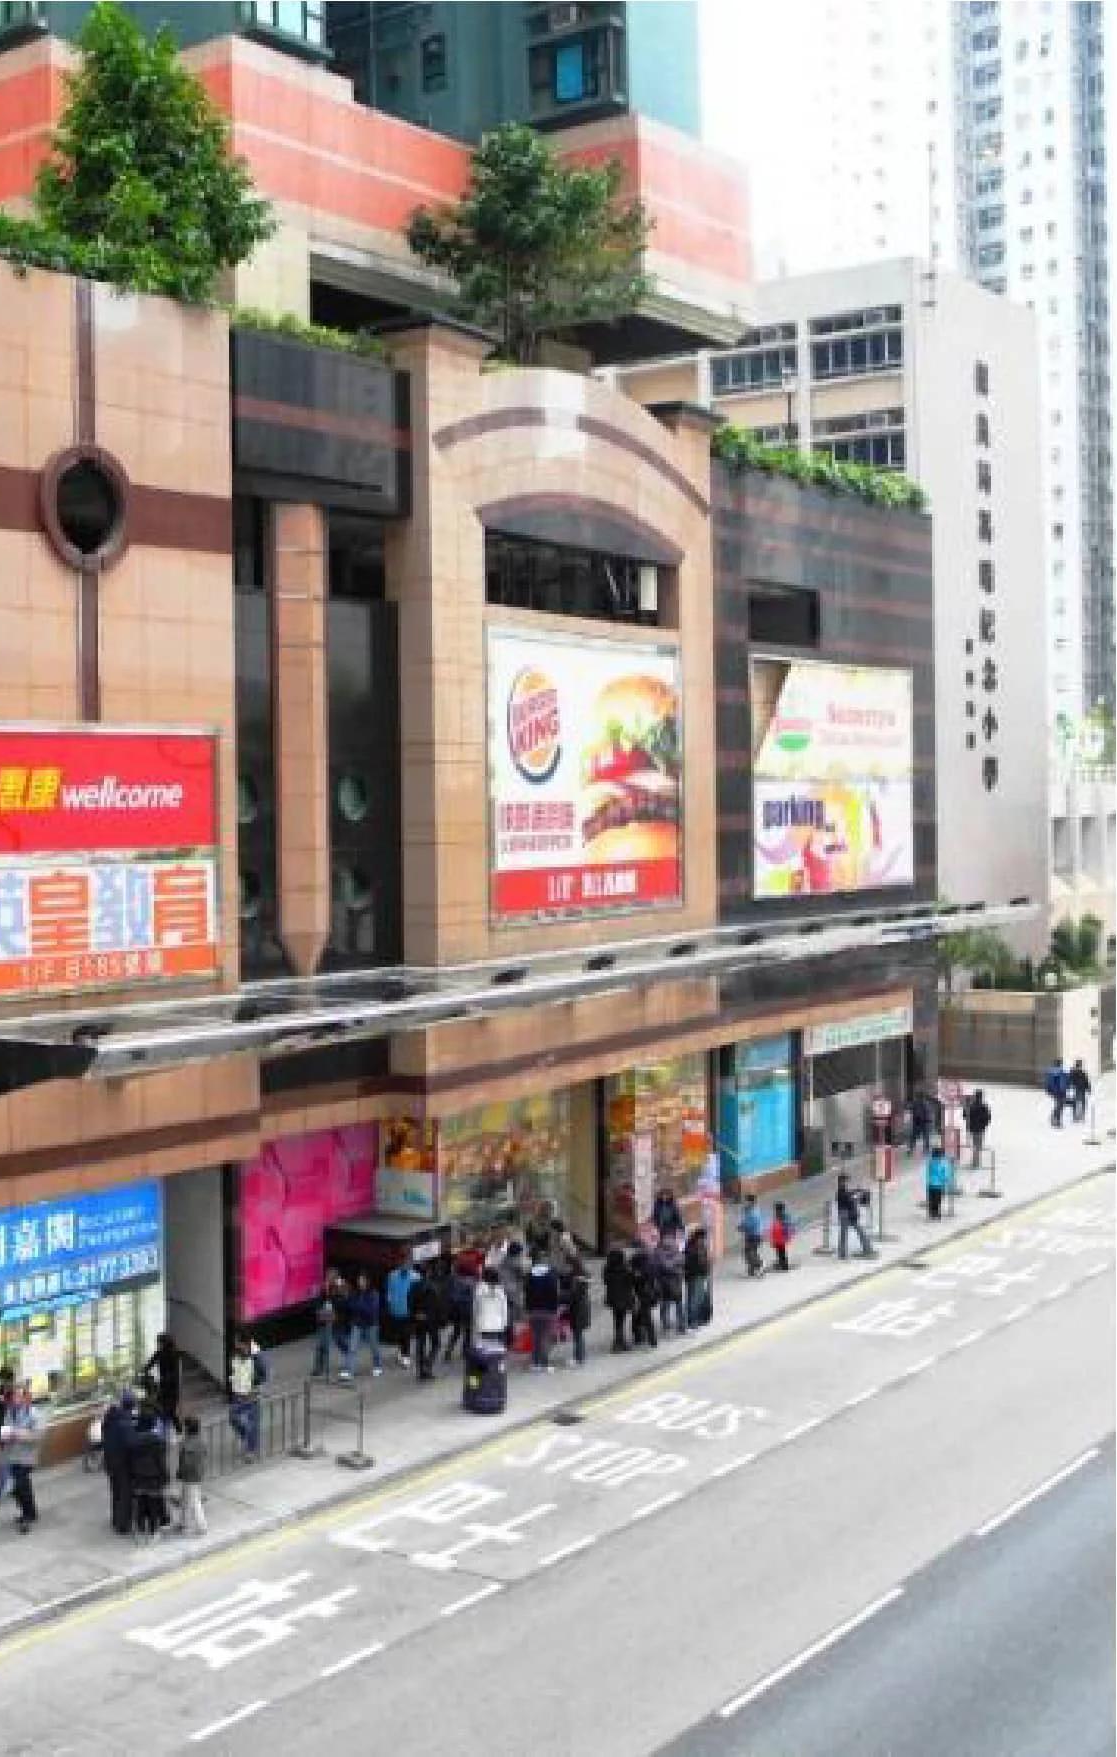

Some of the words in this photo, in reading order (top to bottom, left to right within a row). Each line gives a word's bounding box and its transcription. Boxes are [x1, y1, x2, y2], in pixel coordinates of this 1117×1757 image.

[62, 775, 183, 810] wellcome
[616, 1390, 769, 1440] BUS
[505, 1432, 690, 1486] STOP
[327, 1481, 560, 1571] 巴士
[123, 1570, 360, 1670] 站
